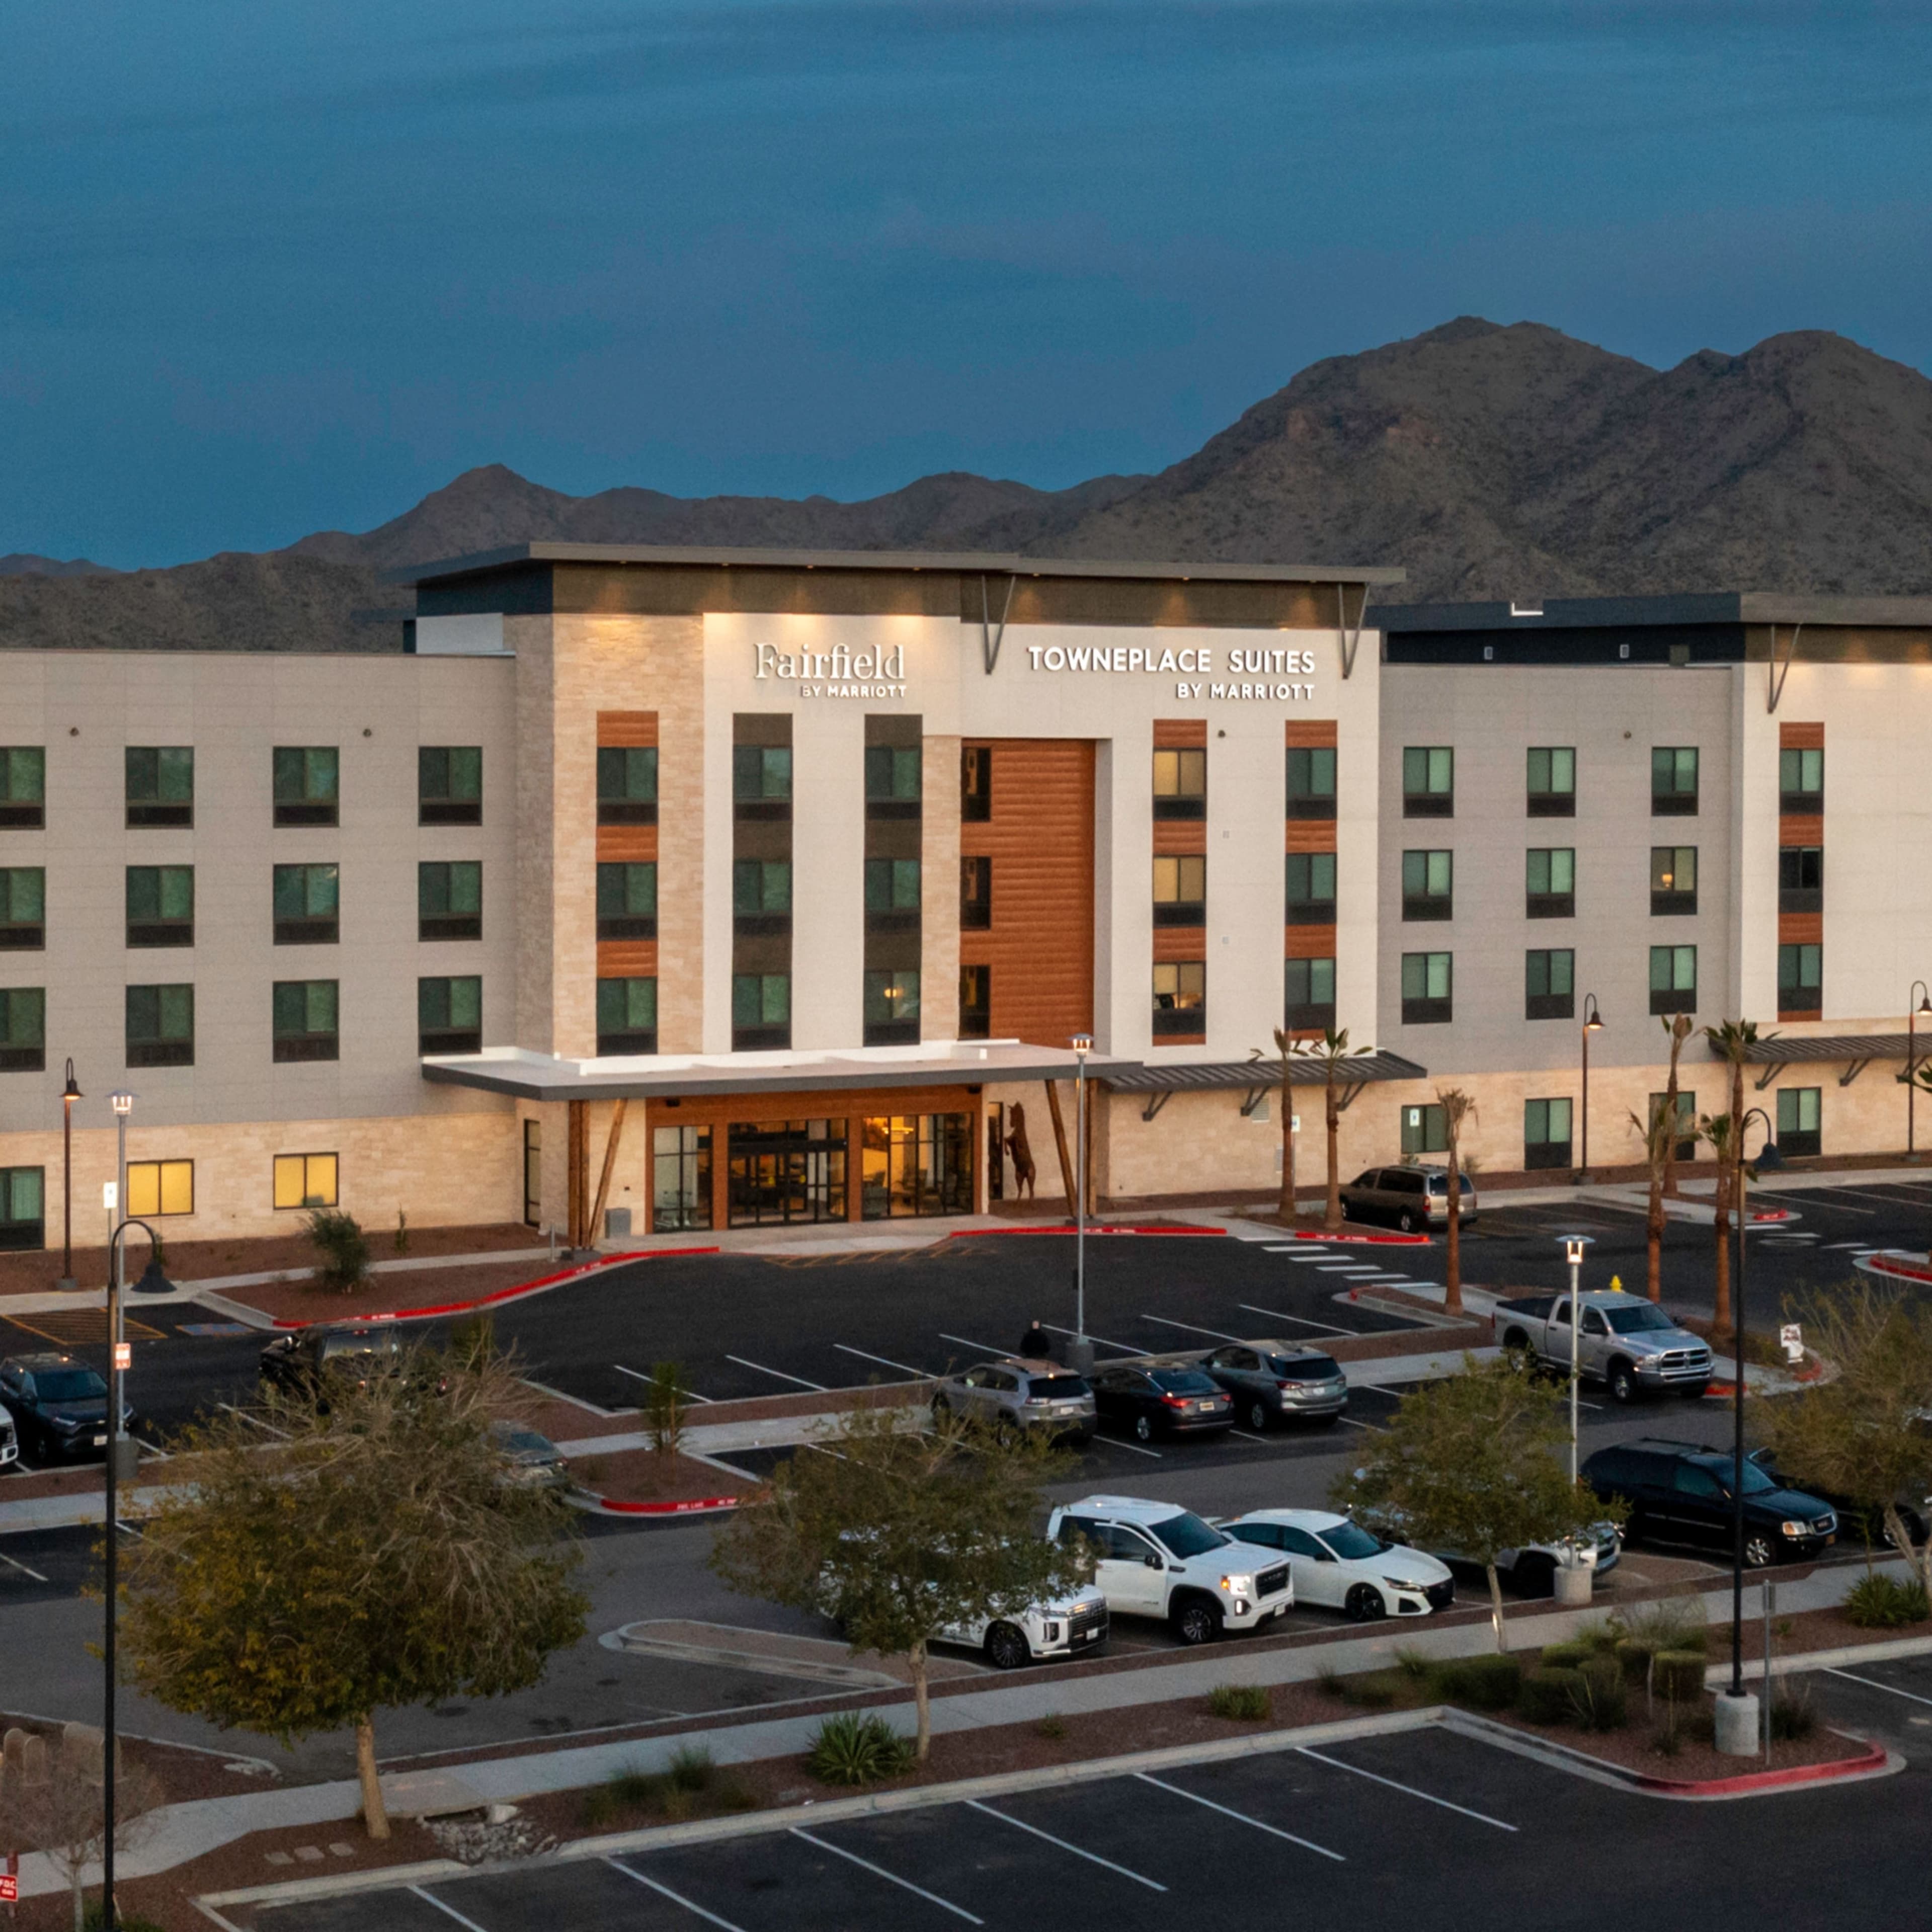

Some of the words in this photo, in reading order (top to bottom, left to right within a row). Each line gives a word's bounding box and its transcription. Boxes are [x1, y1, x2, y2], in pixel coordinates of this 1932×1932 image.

[754, 642, 905, 680] Fairfield
[1027, 646, 1211, 673] TOWNEPLACE
[1229, 650, 1315, 674] SUITES
[801, 685, 821, 697] BY
[827, 685, 907, 698] MARRIOTT
[1176, 683, 1201, 699] BY
[1210, 683, 1315, 700] MARRIOTT
